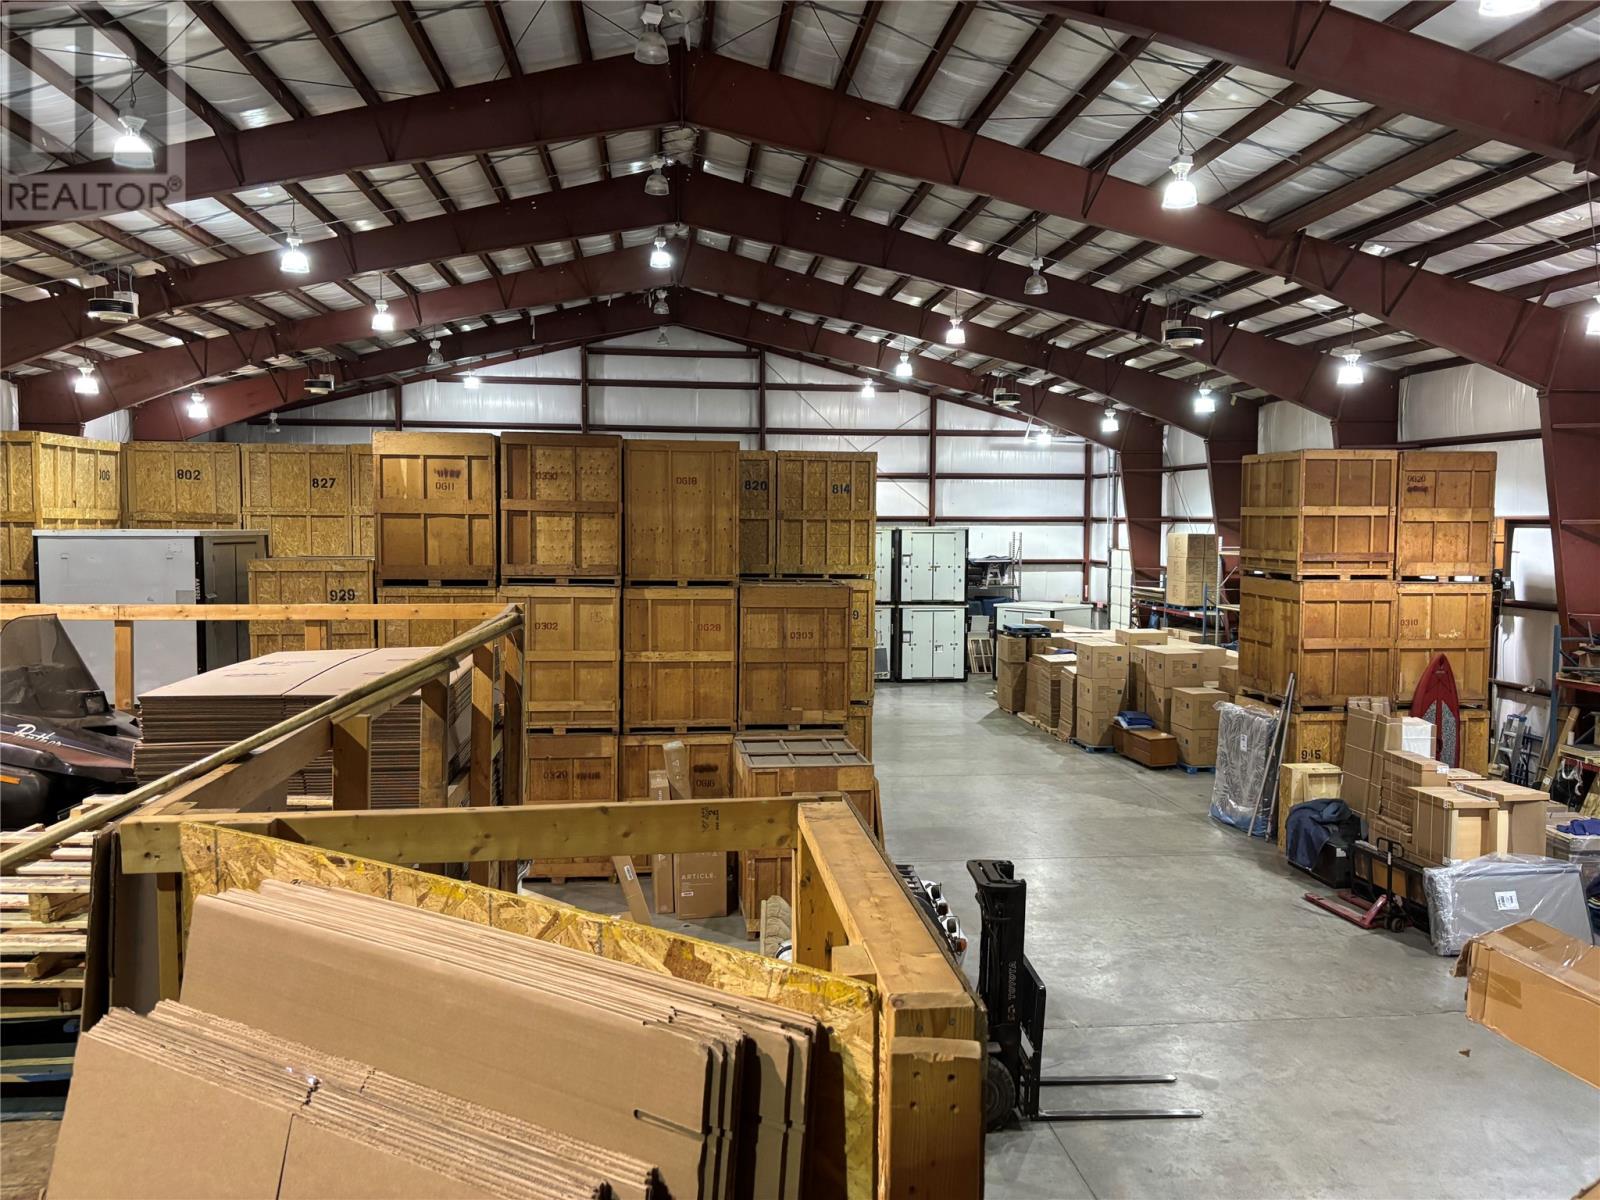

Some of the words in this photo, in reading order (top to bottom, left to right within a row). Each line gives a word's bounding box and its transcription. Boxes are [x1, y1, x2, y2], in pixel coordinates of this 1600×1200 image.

[177, 469, 201, 481] 802
[312, 478, 336, 489] 827
[832, 484, 851, 495] 814
[329, 588, 356, 602] 929
[534, 622, 559, 631] 0302
[1301, 749, 1322, 760] 915
